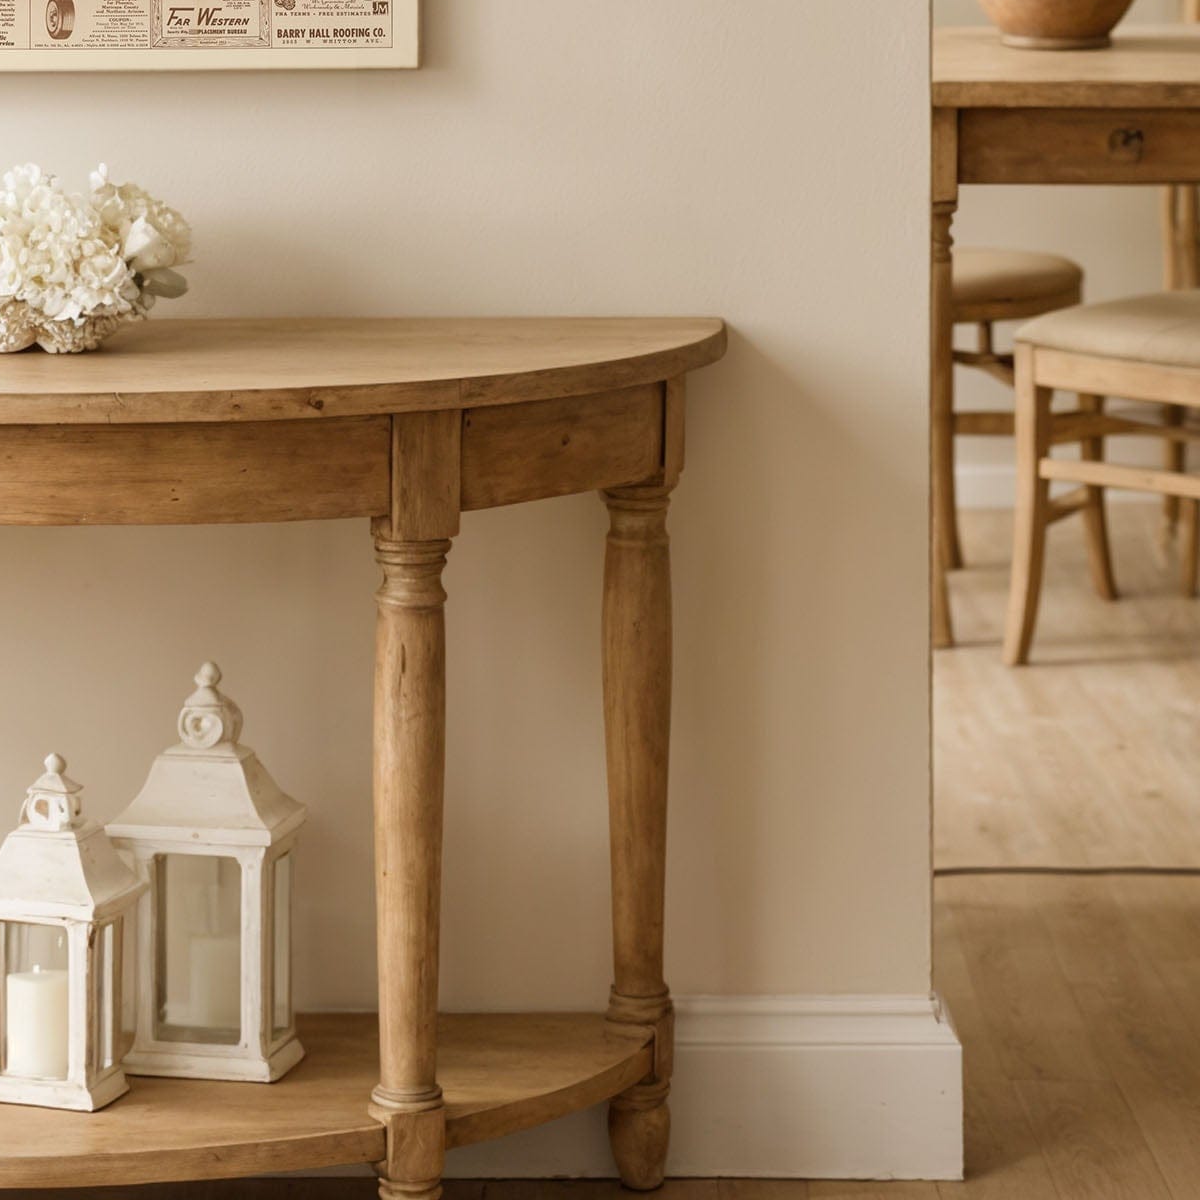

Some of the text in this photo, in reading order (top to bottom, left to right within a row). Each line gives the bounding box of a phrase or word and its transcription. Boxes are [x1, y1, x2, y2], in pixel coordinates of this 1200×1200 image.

[167, 7, 250, 27] FAR WESTERN
[277, 27, 386, 39] BARRY HALL ROOFING CO.
